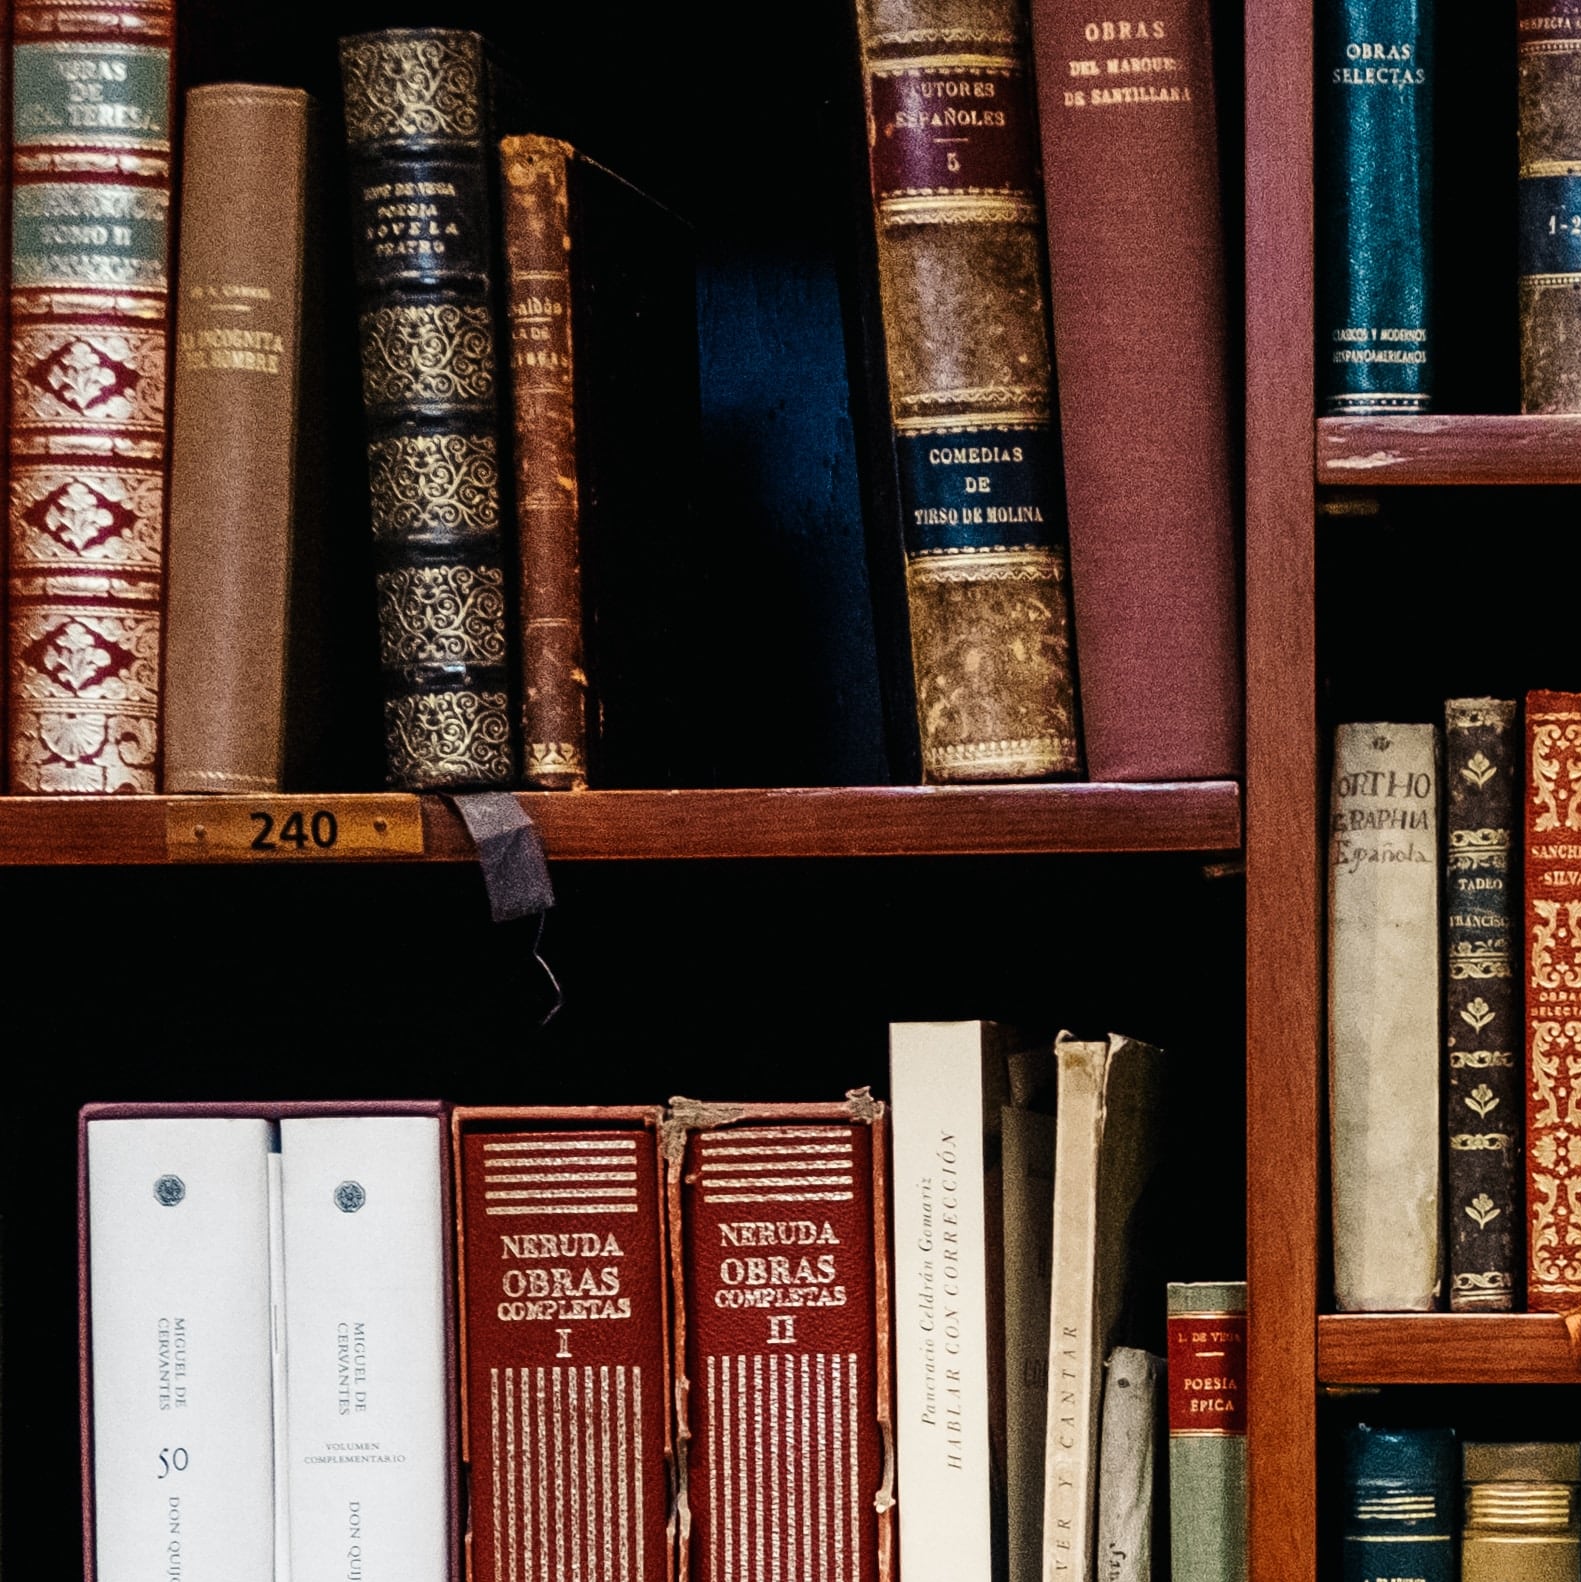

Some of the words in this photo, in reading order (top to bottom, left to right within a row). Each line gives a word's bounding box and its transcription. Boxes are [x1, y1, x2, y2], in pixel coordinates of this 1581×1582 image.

[1085, 21, 1166, 42] OBRAS
[1346, 43, 1411, 62] OBRAS
[1333, 67, 1426, 86] SELECTAS
[929, 447, 1023, 465] COMEDIAS
[965, 477, 991, 493] DE
[915, 507, 958, 525] TIRSO
[963, 508, 983, 524] DE
[986, 506, 1044, 523] MOLINA
[249, 810, 338, 850] 240
[918, 1176, 934, 1253] Gomariz
[936, 1129, 960, 1296] CORRECCIÓN
[501, 1232, 624, 1260] NERUDA
[718, 1221, 839, 1247] NERUDA
[502, 1266, 620, 1298] OBRAS
[720, 1255, 836, 1285] OBRAS
[497, 1298, 631, 1321] COMPLETAS
[715, 1285, 847, 1309] COMPLETAS
[919, 1260, 936, 1333] Celdrán
[946, 1307, 961, 1357] CON
[158, 1318, 171, 1411] CERVANTES
[173, 1317, 187, 1382] MIGUEL
[175, 1385, 188, 1409] DE
[920, 1341, 937, 1427] Pancracio
[1062, 1325, 1078, 1450] CANTAR
[947, 1367, 963, 1471] HABLAR
[1059, 1476, 1073, 1489] Y
[169, 1497, 181, 1535] DON
[1055, 1517, 1073, 1572] VER
